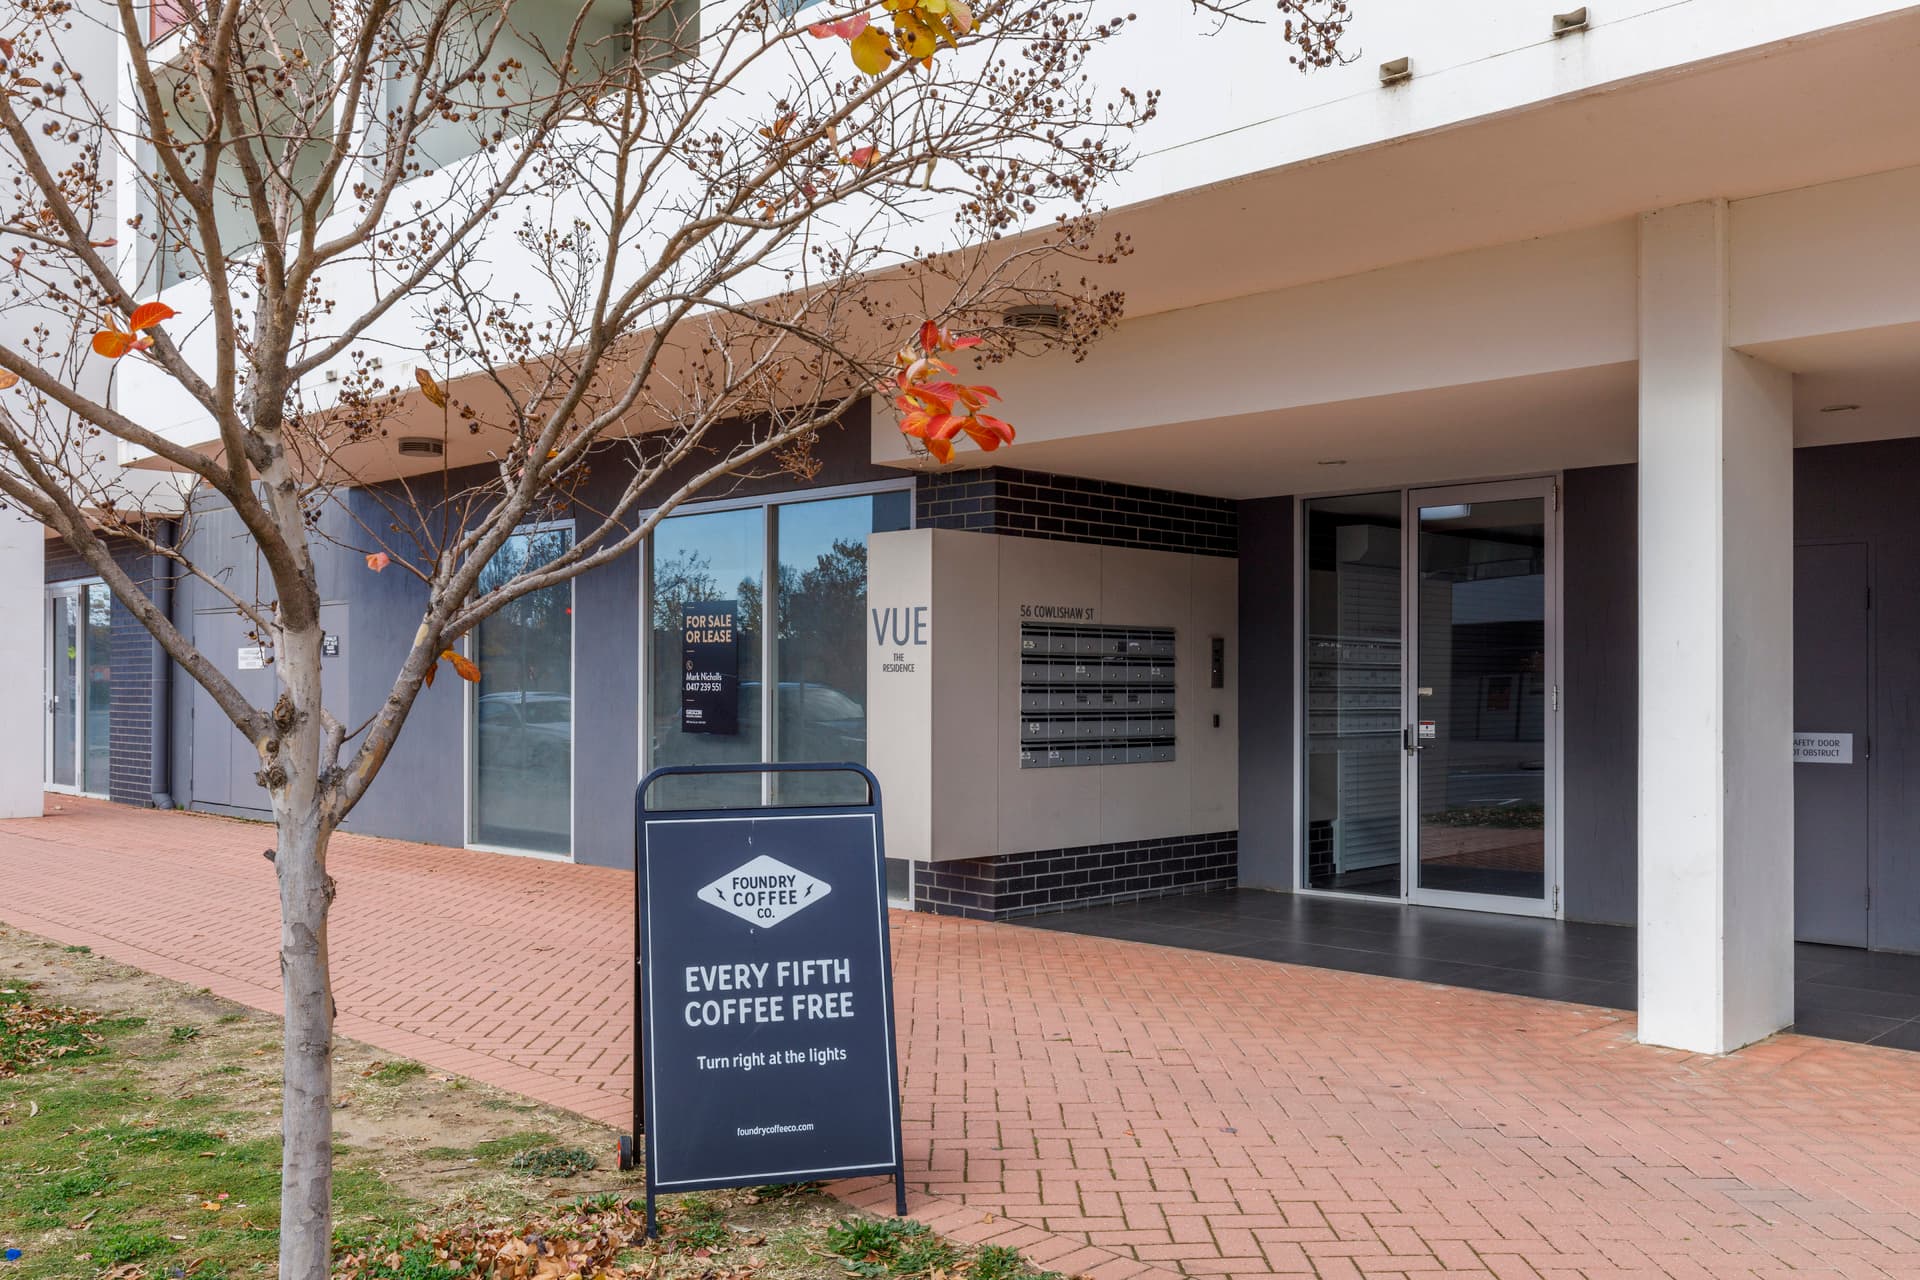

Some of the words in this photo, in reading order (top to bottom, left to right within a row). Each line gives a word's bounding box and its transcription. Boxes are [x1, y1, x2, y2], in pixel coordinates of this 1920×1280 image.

[1020, 605, 1032, 617] 56
[1034, 606, 1083, 620] COWLISHAW
[1085, 608, 1095, 620] ST
[686, 616, 706, 628] FOR
[708, 614, 732, 627] SALE
[872, 606, 928, 646] VUE
[685, 630, 701, 643] OR
[702, 629, 732, 643] LEASE
[893, 652, 905, 662] THE
[882, 663, 915, 673] RESIDENCE
[685, 672, 700, 681] Mark
[700, 672, 722, 681] Nicholls
[686, 683, 700, 692] 0417
[700, 683, 711, 692] 239
[711, 683, 722, 692] 551
[1793, 739, 1815, 747] AFETY
[1817, 739, 1840, 747] DOOR
[1802, 748, 1839, 757] OBSTRUCT
[732, 875, 796, 890] FOUNDRY
[733, 890, 798, 907] COFFEE
[757, 908, 775, 919] CO.
[685, 962, 769, 993] EVERY
[776, 958, 851, 988] FIFTH
[684, 995, 785, 1027] COFFEE
[791, 991, 855, 1022] FREE
[696, 1055, 730, 1070] Turn
[732, 1052, 765, 1071] right
[768, 1051, 782, 1065] at
[784, 1049, 806, 1064] the
[809, 1047, 848, 1066] lights
[736, 1123, 814, 1137] foundrycoffeeco.com
